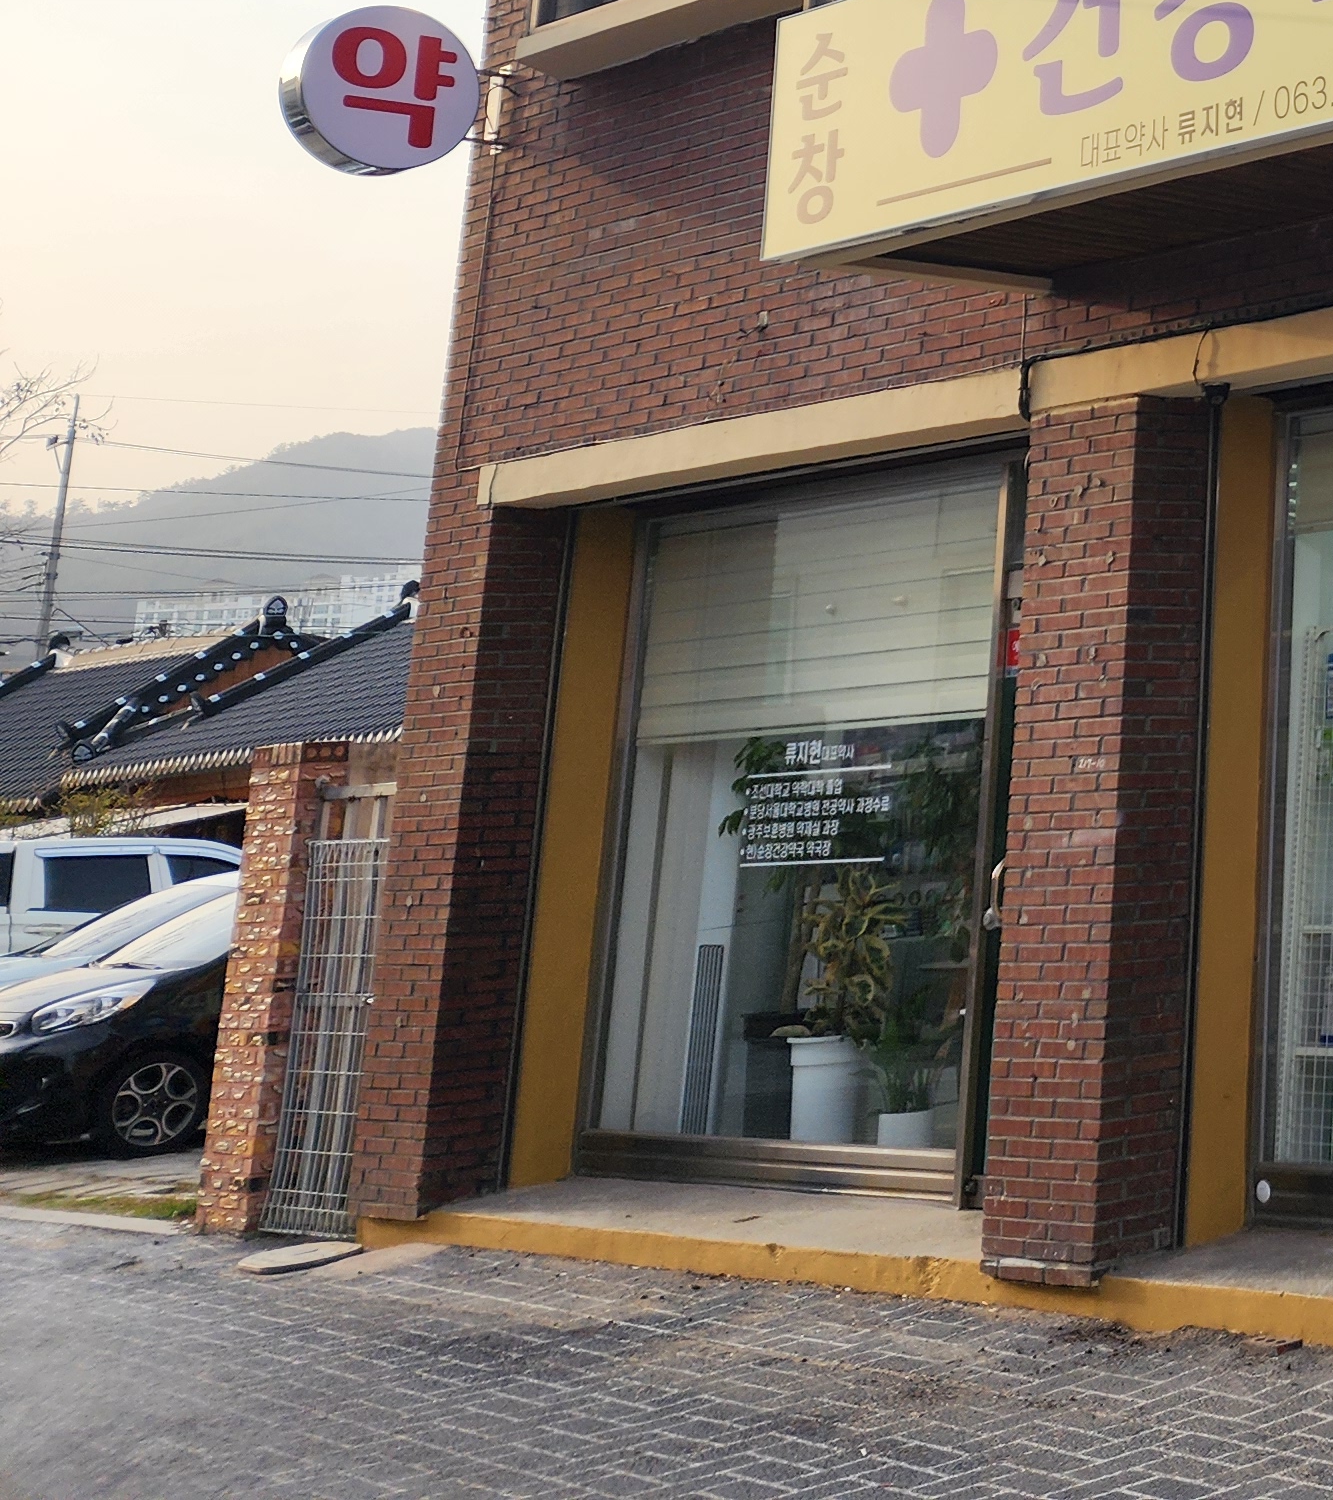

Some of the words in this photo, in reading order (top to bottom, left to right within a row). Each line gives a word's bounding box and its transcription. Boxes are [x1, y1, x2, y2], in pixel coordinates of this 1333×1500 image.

[332, 26, 458, 149] 약
[787, 30, 848, 226] 순창
[1080, 115, 1169, 168] 대표약사
[1177, 97, 1244, 145] 류지현
[785, 739, 823, 765] 류지현
[750, 782, 790, 799] 조선대학교
[792, 780, 824, 797] 약학대학
[749, 801, 820, 820] 분당서울대학교병원
[821, 798, 855, 816] 전공약사
[856, 795, 890, 813] 과정수료
[747, 822, 795, 840] 광주보훈병원
[806, 840, 831, 857] 약국장
